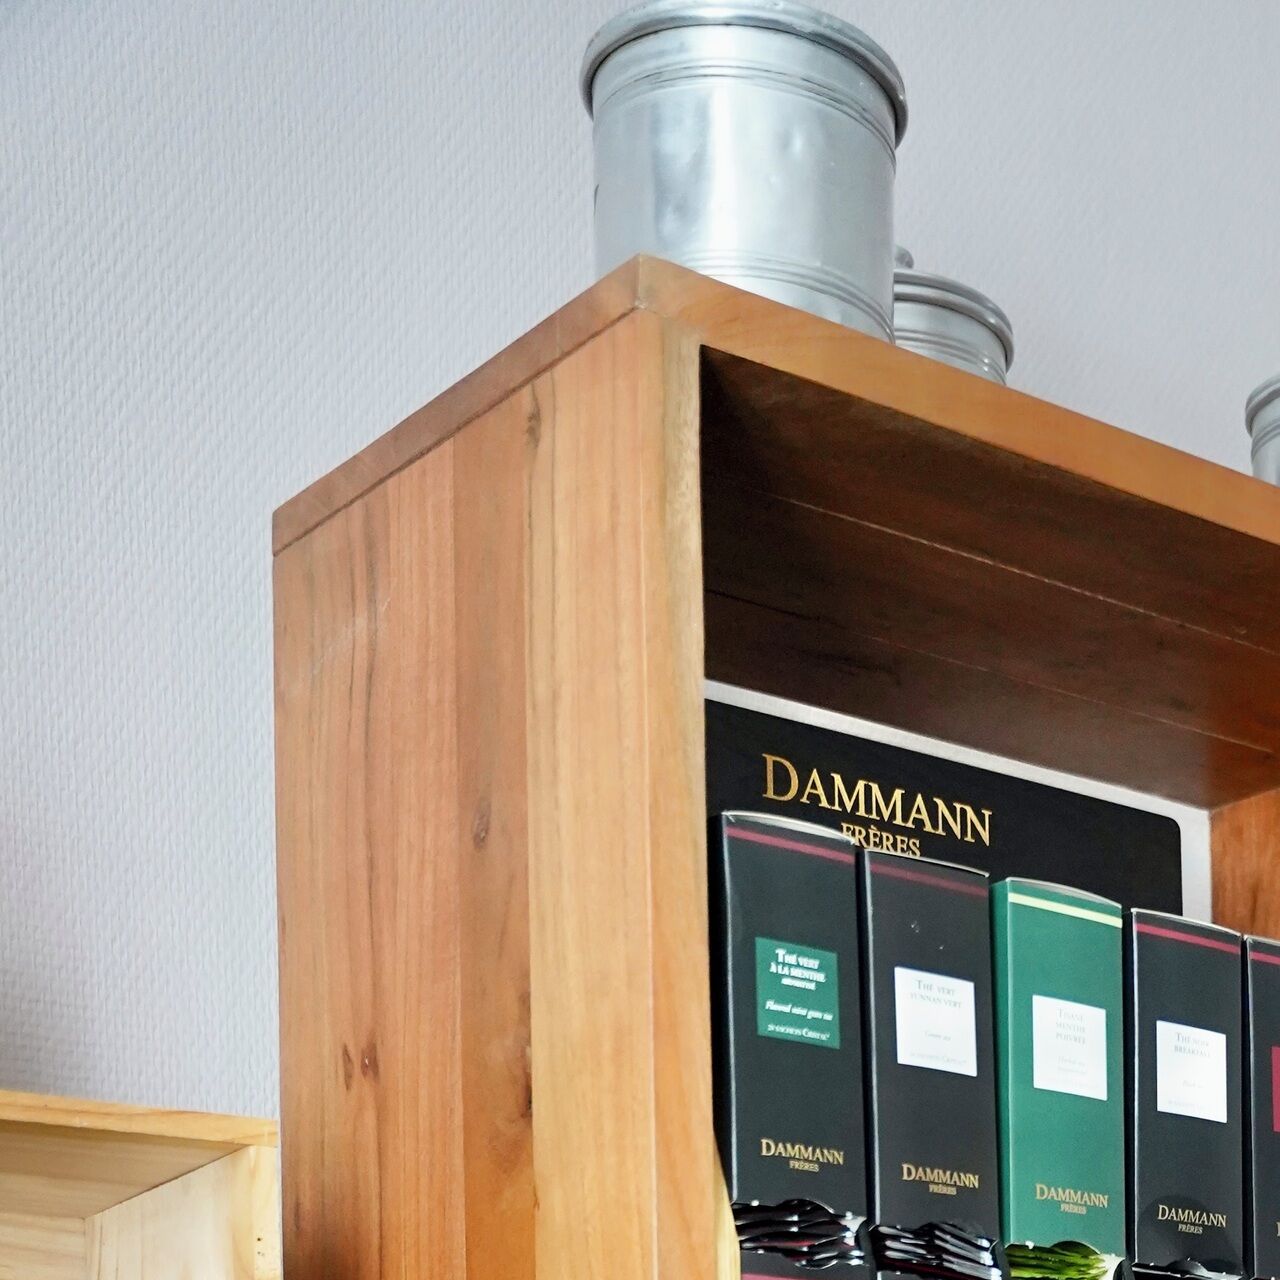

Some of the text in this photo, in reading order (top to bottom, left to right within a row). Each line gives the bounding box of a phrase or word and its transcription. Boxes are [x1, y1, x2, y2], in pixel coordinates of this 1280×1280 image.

[762, 753, 993, 847] DAMMANN
[840, 822, 921, 857] FRÈRES
[761, 1138, 844, 1165] DAMMANN
[902, 1163, 979, 1189] DAMMANN
[1036, 1183, 1108, 1209] DAMMANN
[1158, 1204, 1227, 1228] DAMMANN
